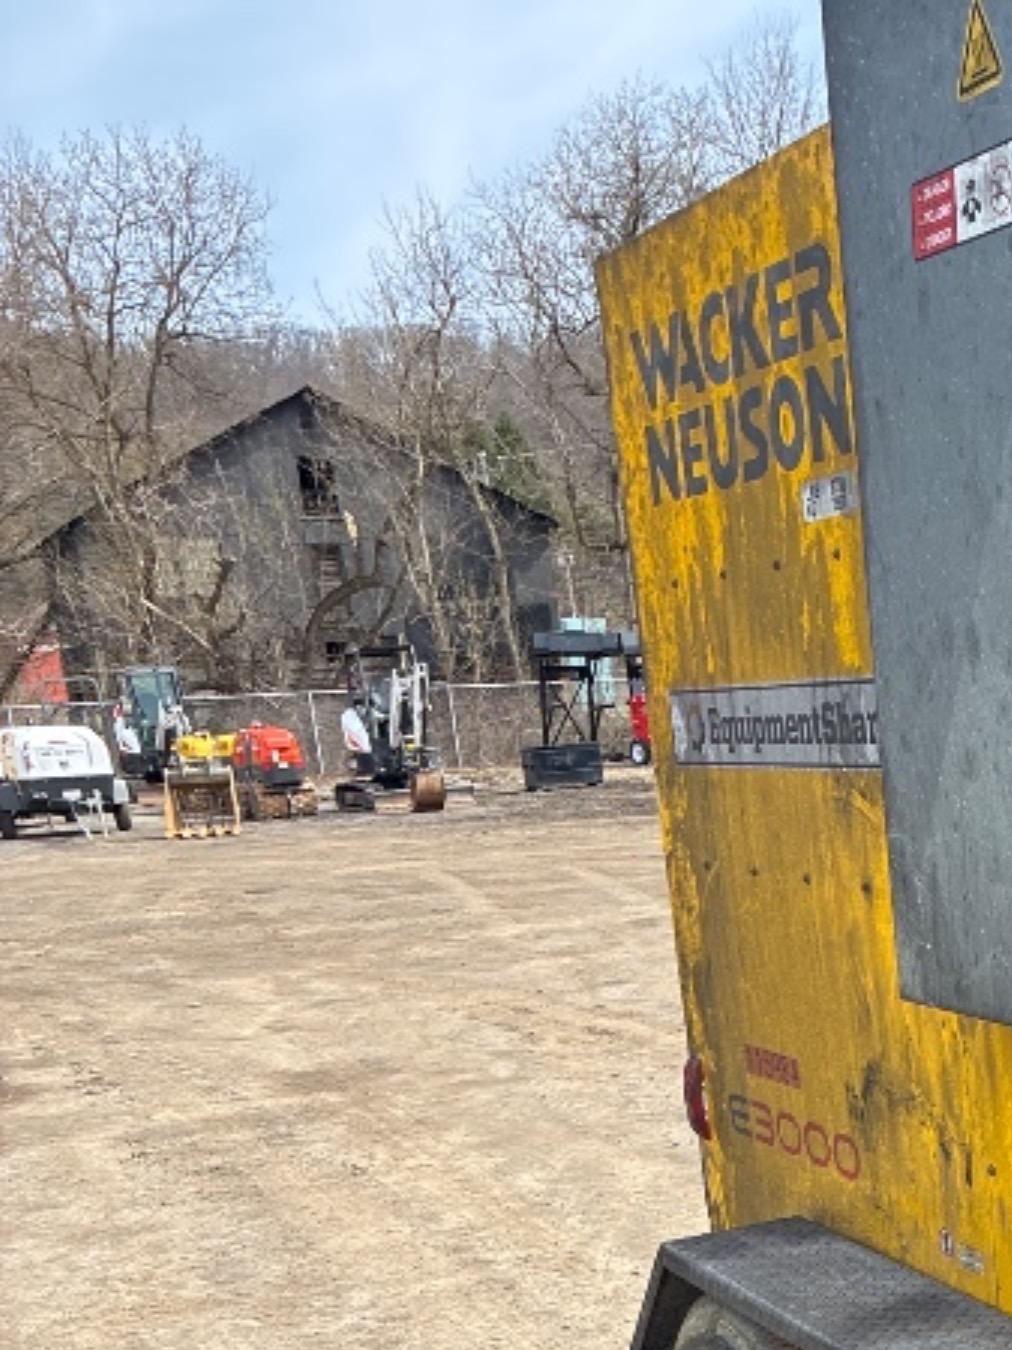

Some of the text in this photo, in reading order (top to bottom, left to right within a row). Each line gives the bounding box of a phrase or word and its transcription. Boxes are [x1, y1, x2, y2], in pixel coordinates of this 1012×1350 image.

[630, 243, 842, 411] WACKER
[645, 354, 854, 506] NEUSON
[728, 1094, 861, 1180] E3000
